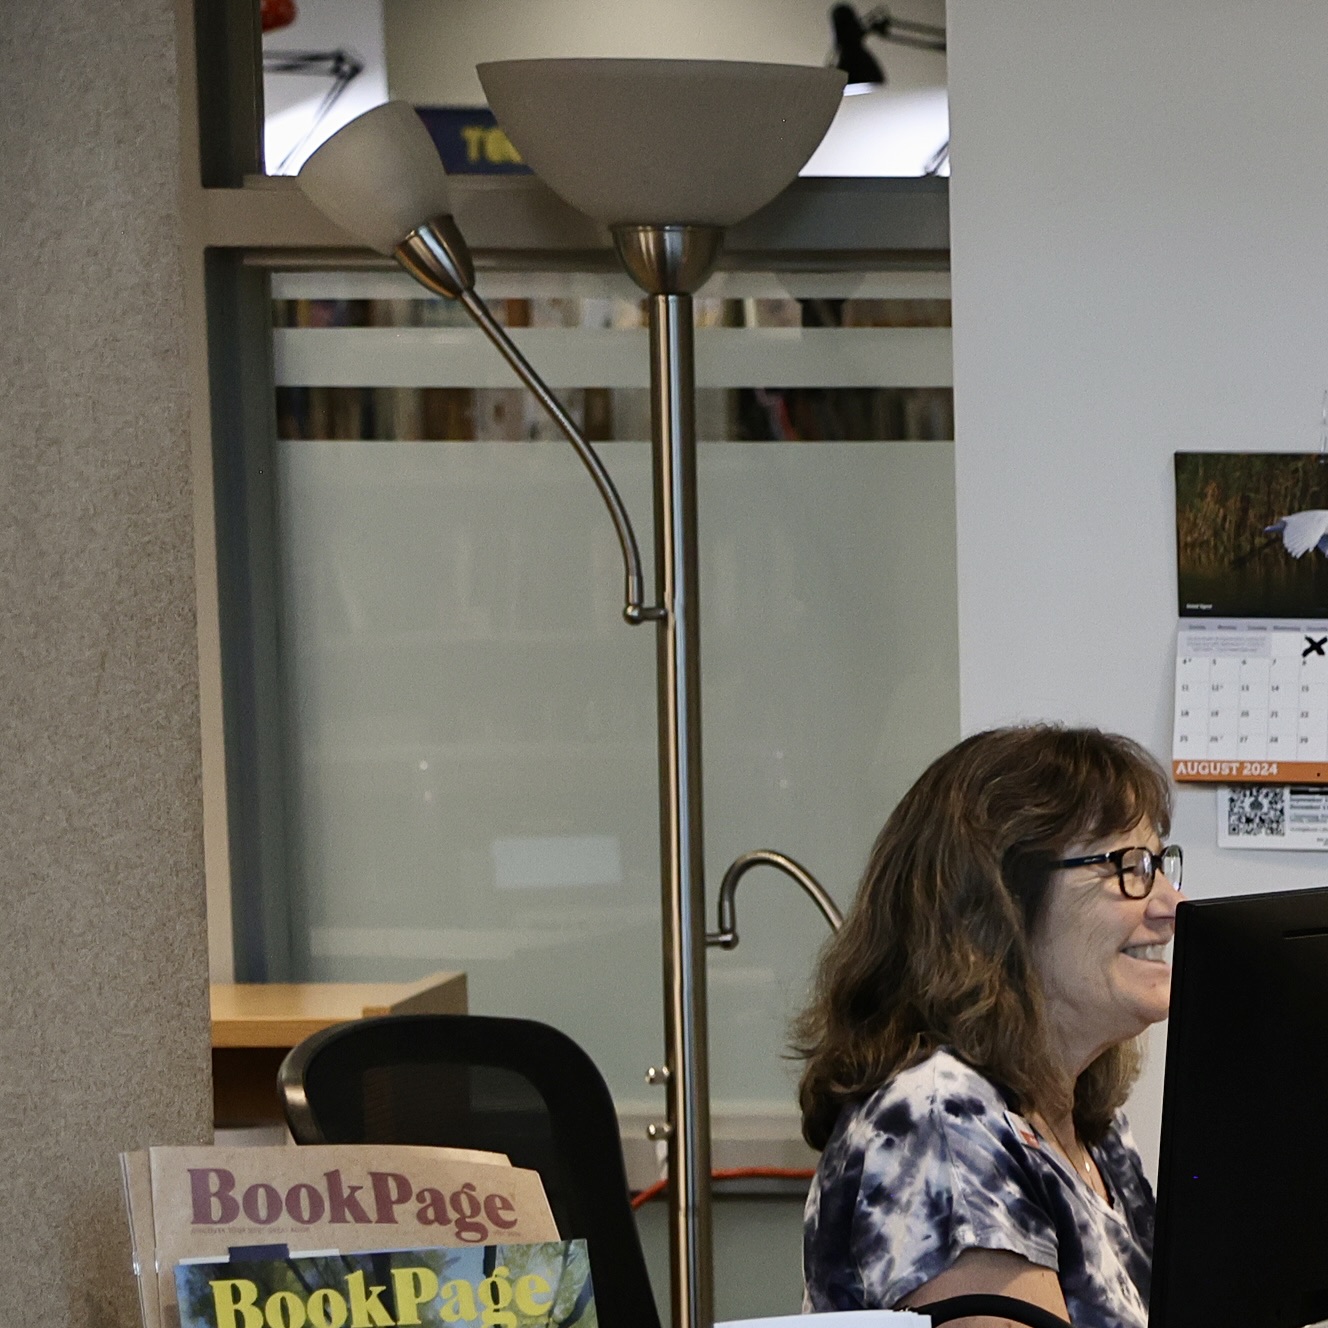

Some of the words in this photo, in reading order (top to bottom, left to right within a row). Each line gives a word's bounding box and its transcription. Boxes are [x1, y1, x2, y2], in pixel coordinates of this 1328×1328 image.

[1176, 762, 1240, 775] AUGUST
[1243, 763, 1278, 775] 2024
[187, 1168, 518, 1243] BookPage
